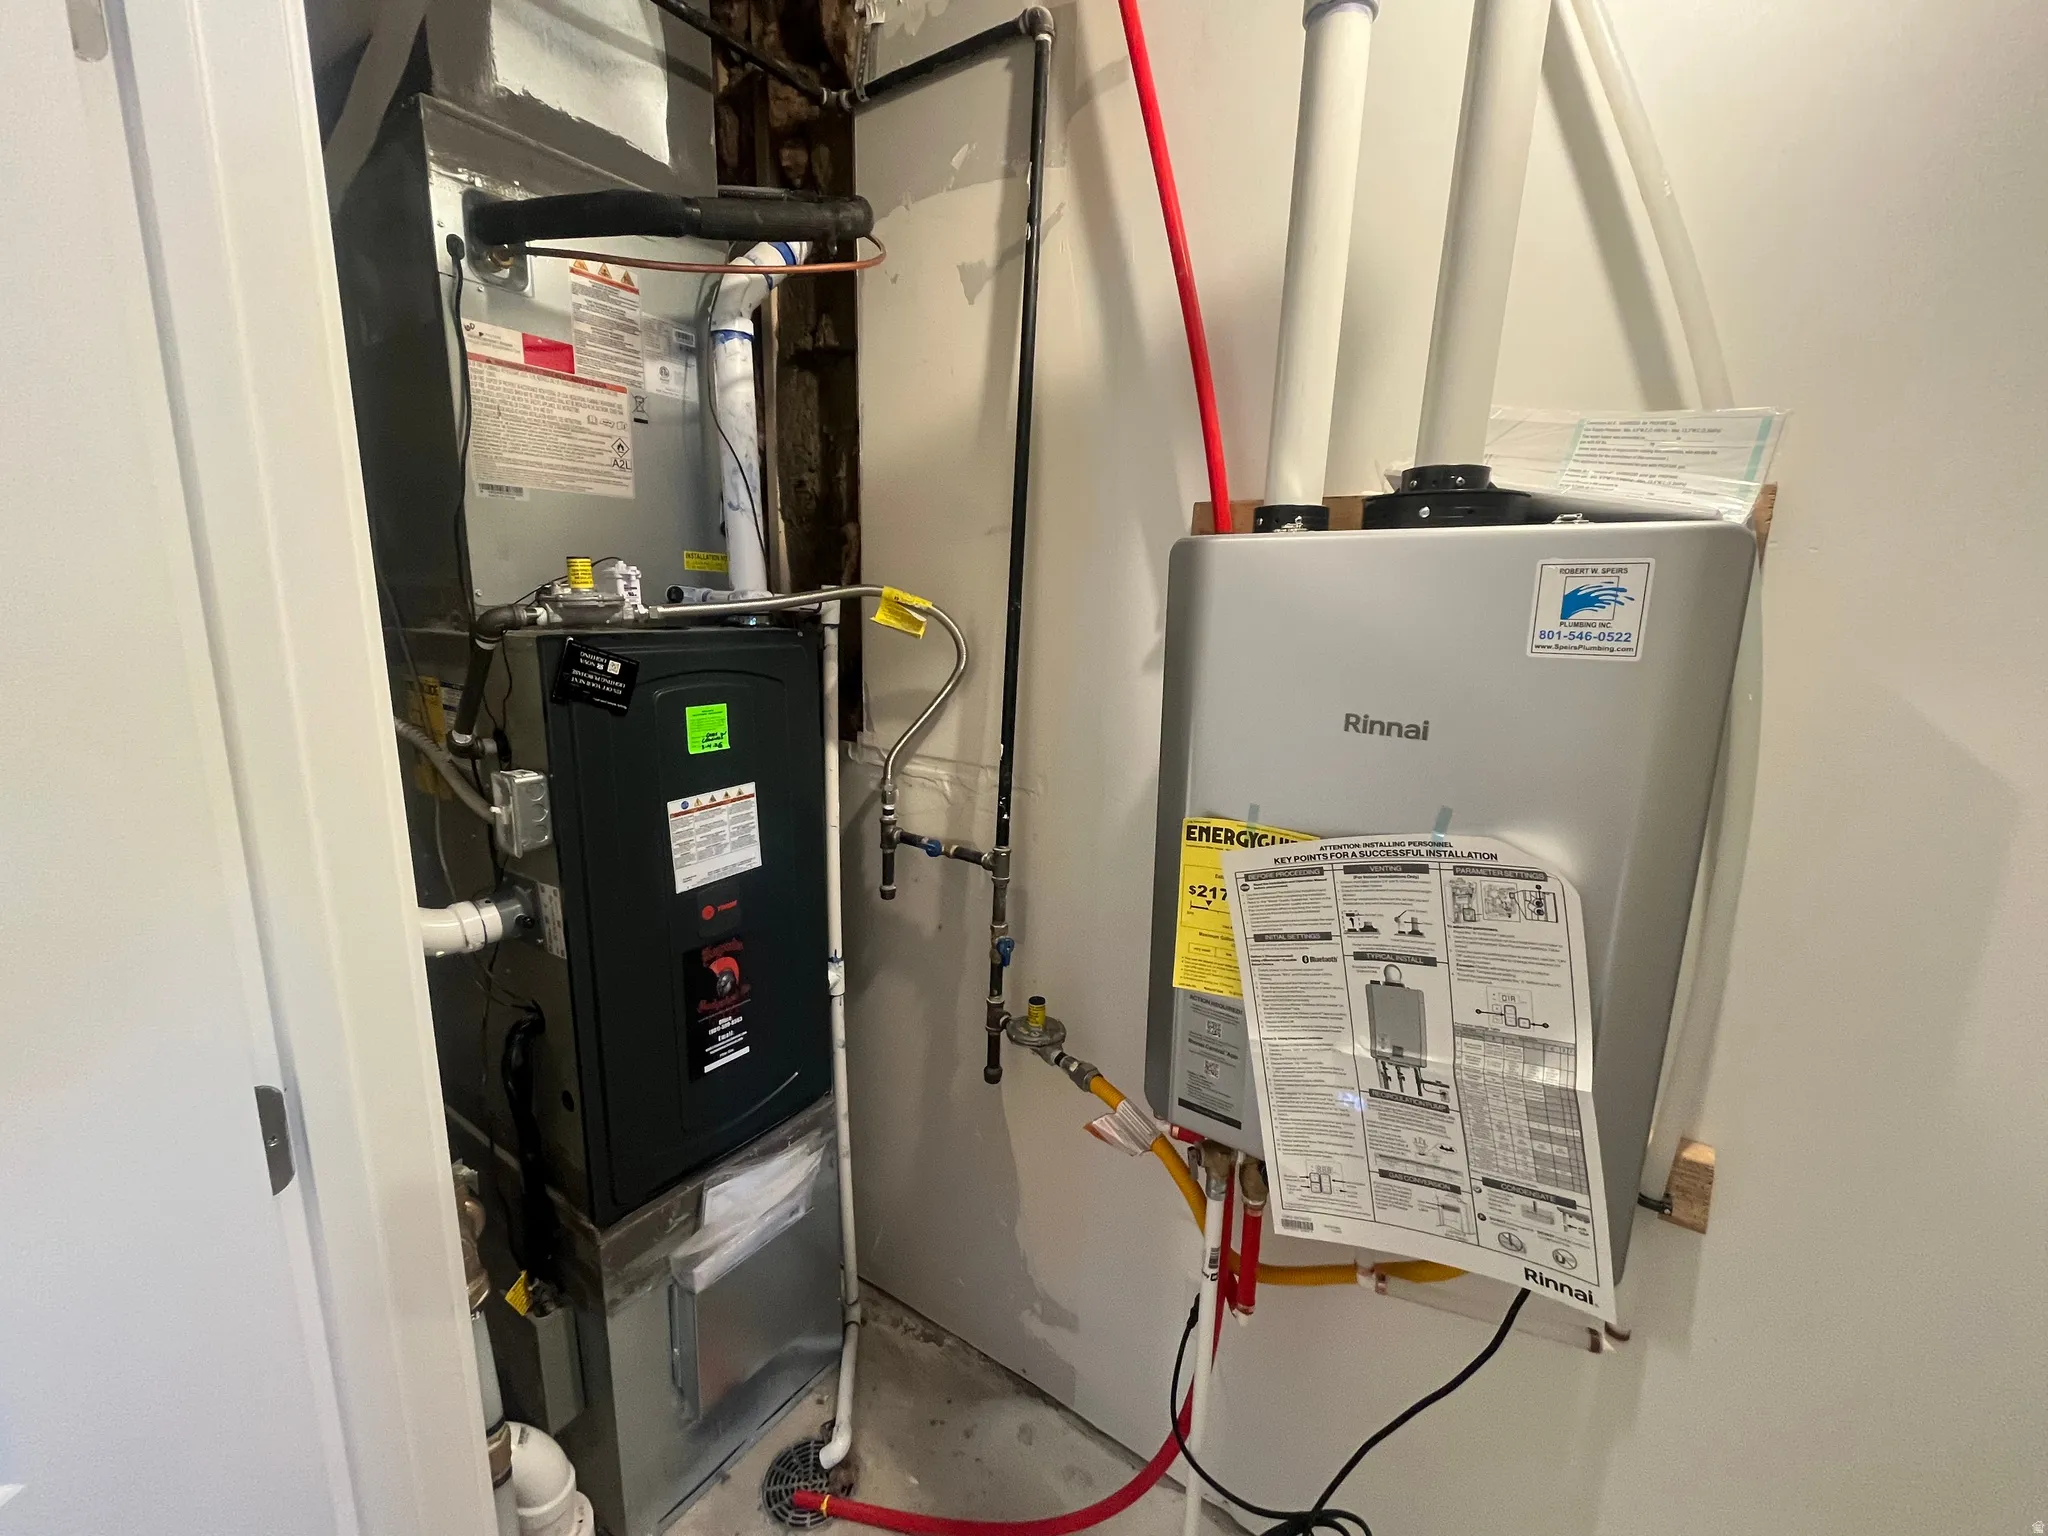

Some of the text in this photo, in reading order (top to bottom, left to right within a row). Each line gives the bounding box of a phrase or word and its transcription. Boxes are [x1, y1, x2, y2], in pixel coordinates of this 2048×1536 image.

[612, 459, 632, 470] A2L
[1559, 567, 1589, 575] ROBERT
[1601, 567, 1629, 575] SPEIRS
[1598, 621, 1613, 629] INC.
[1538, 629, 1632, 643] 801-546-0522
[1534, 643, 1634, 653] www.SpeirsPlumbing.com
[1343, 712, 1430, 741] Rinnai
[1319, 840, 1454, 852] ATTENTION: INSTALLING PERSONNEL
[1273, 848, 1498, 865] KEY POINTS FOR A SUCCESSFUL INSTALLATION
[1247, 868, 1321, 881] BEFORE PROCEEDING
[1455, 866, 1545, 880] PARAMETER SETTINGS
[1188, 884, 1228, 901] $217
[1287, 932, 1321, 940] SETTINGS
[1366, 952, 1424, 964] TYPICAL INSTALL
[1388, 1171, 1404, 1182] GAS
[1500, 1182, 1556, 1203] CONDENSATE
[1524, 1266, 1595, 1306] Rinnai
